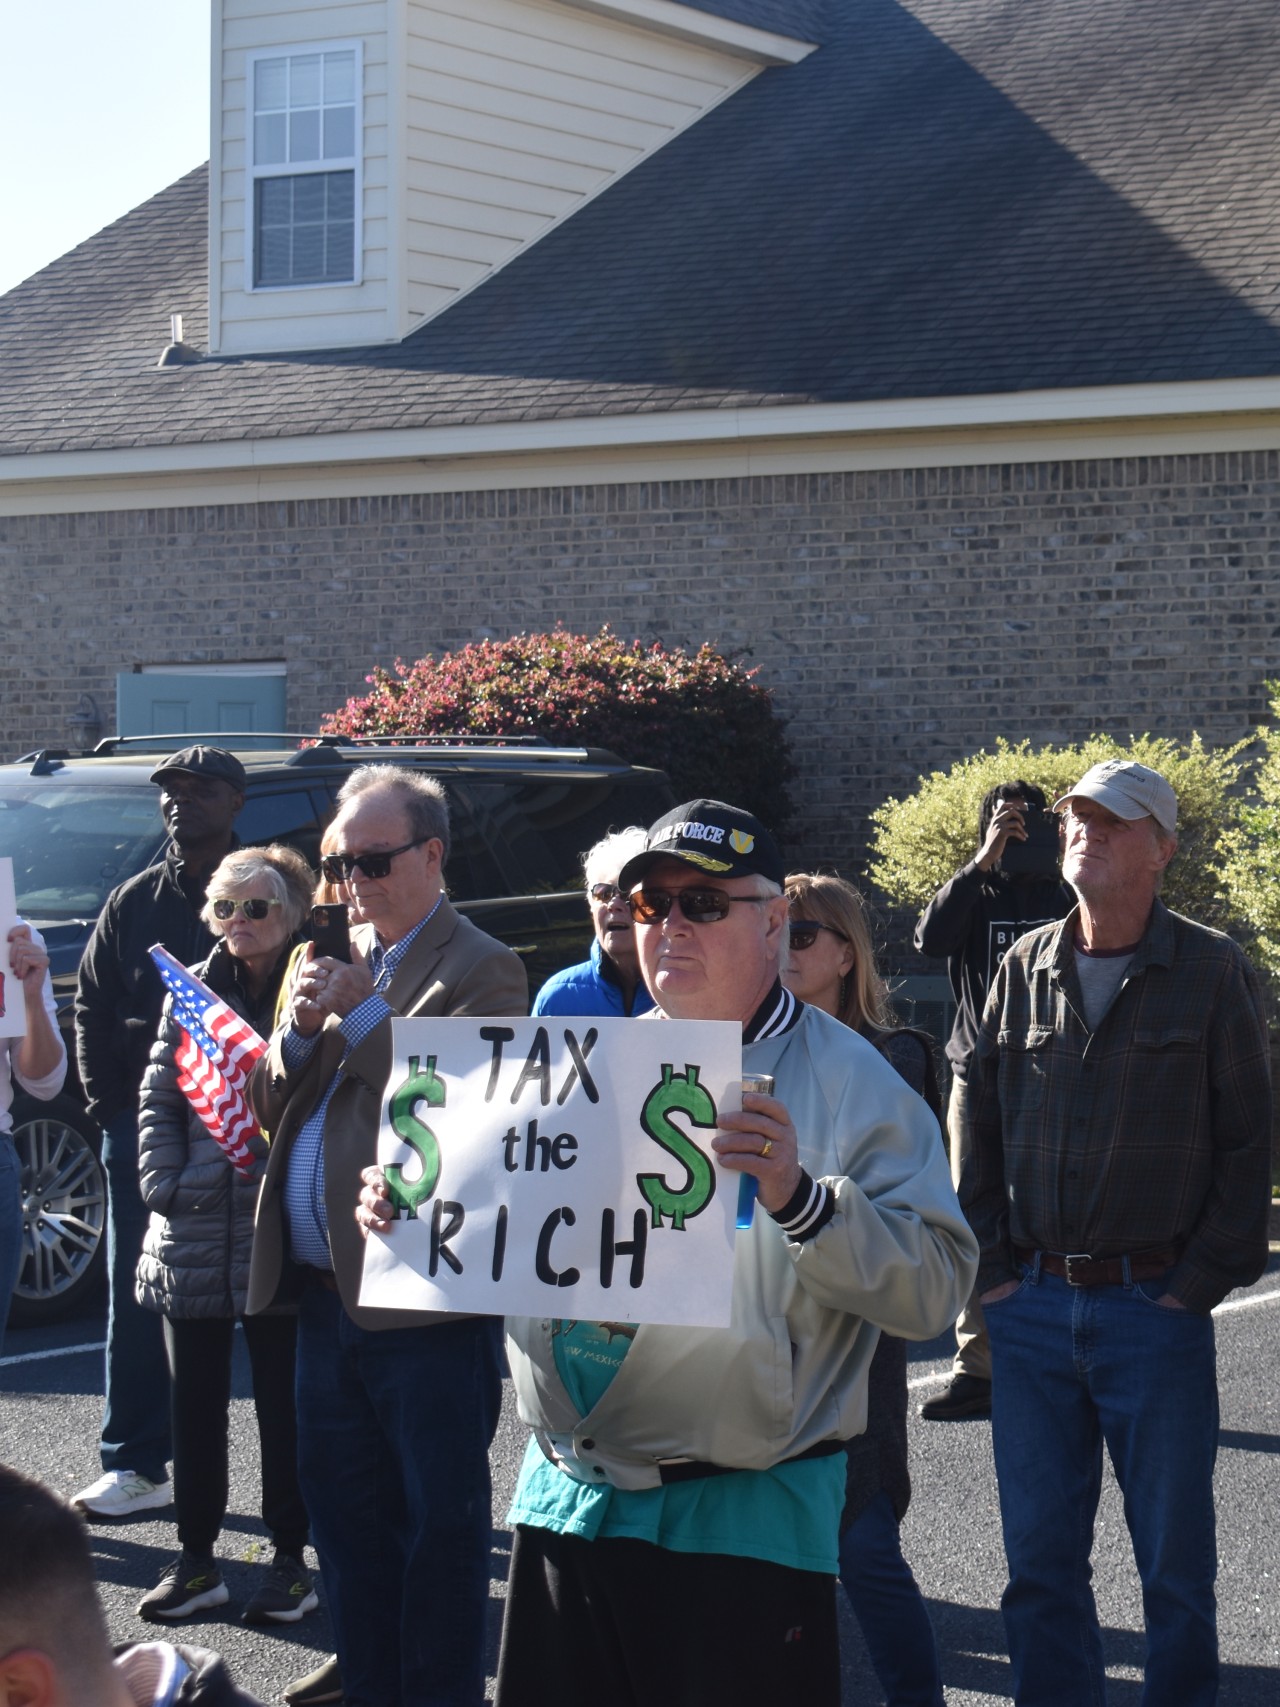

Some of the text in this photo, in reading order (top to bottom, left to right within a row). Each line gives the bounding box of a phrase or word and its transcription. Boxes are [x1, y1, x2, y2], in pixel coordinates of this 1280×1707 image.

[649, 821, 726, 849] AIR FORCE
[997, 931, 1026, 945] BL
[480, 1026, 600, 1106] TAX
[501, 1119, 579, 1172] the
[428, 1198, 648, 1289] RICH
